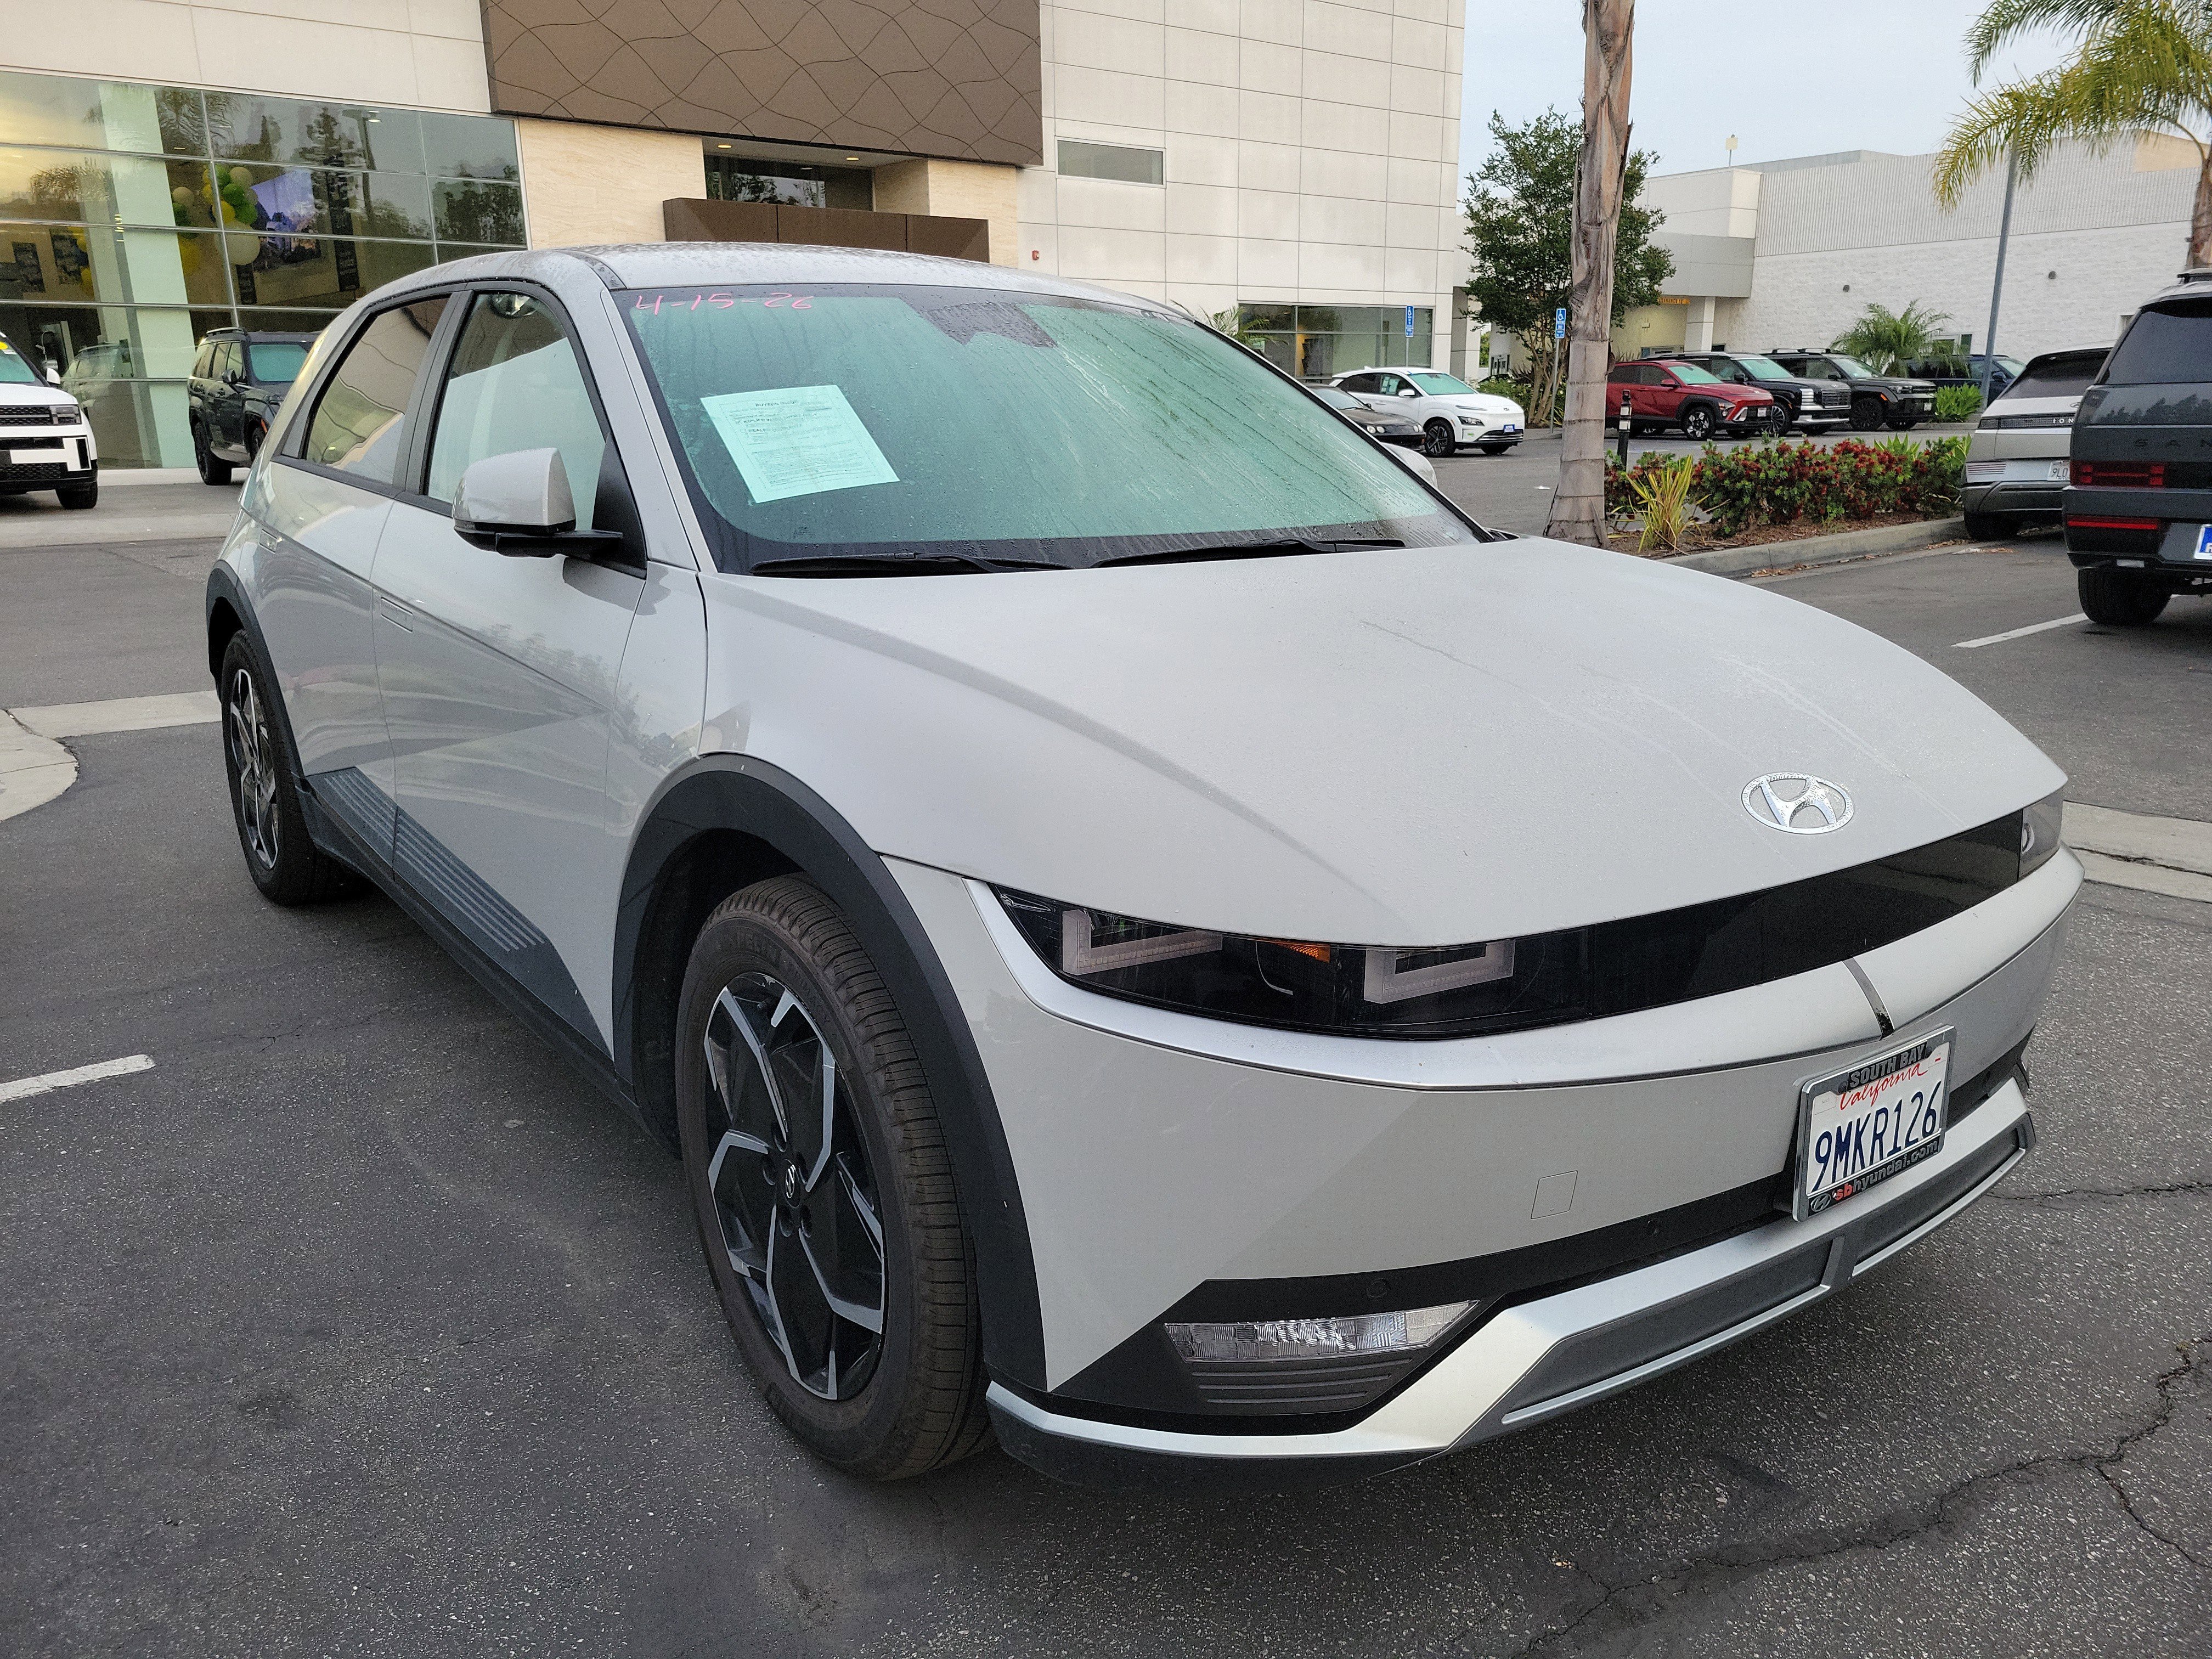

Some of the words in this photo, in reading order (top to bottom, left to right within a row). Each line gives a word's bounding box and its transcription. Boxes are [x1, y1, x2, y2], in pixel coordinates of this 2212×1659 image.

[635, 292, 814, 316] 4-15-26
[1840, 1063, 1928, 1110] California
[1849, 1056, 1897, 1088] SOUTH
[1900, 1044, 1926, 1065] BAY
[1812, 1080, 1942, 1192] 9MKR126
